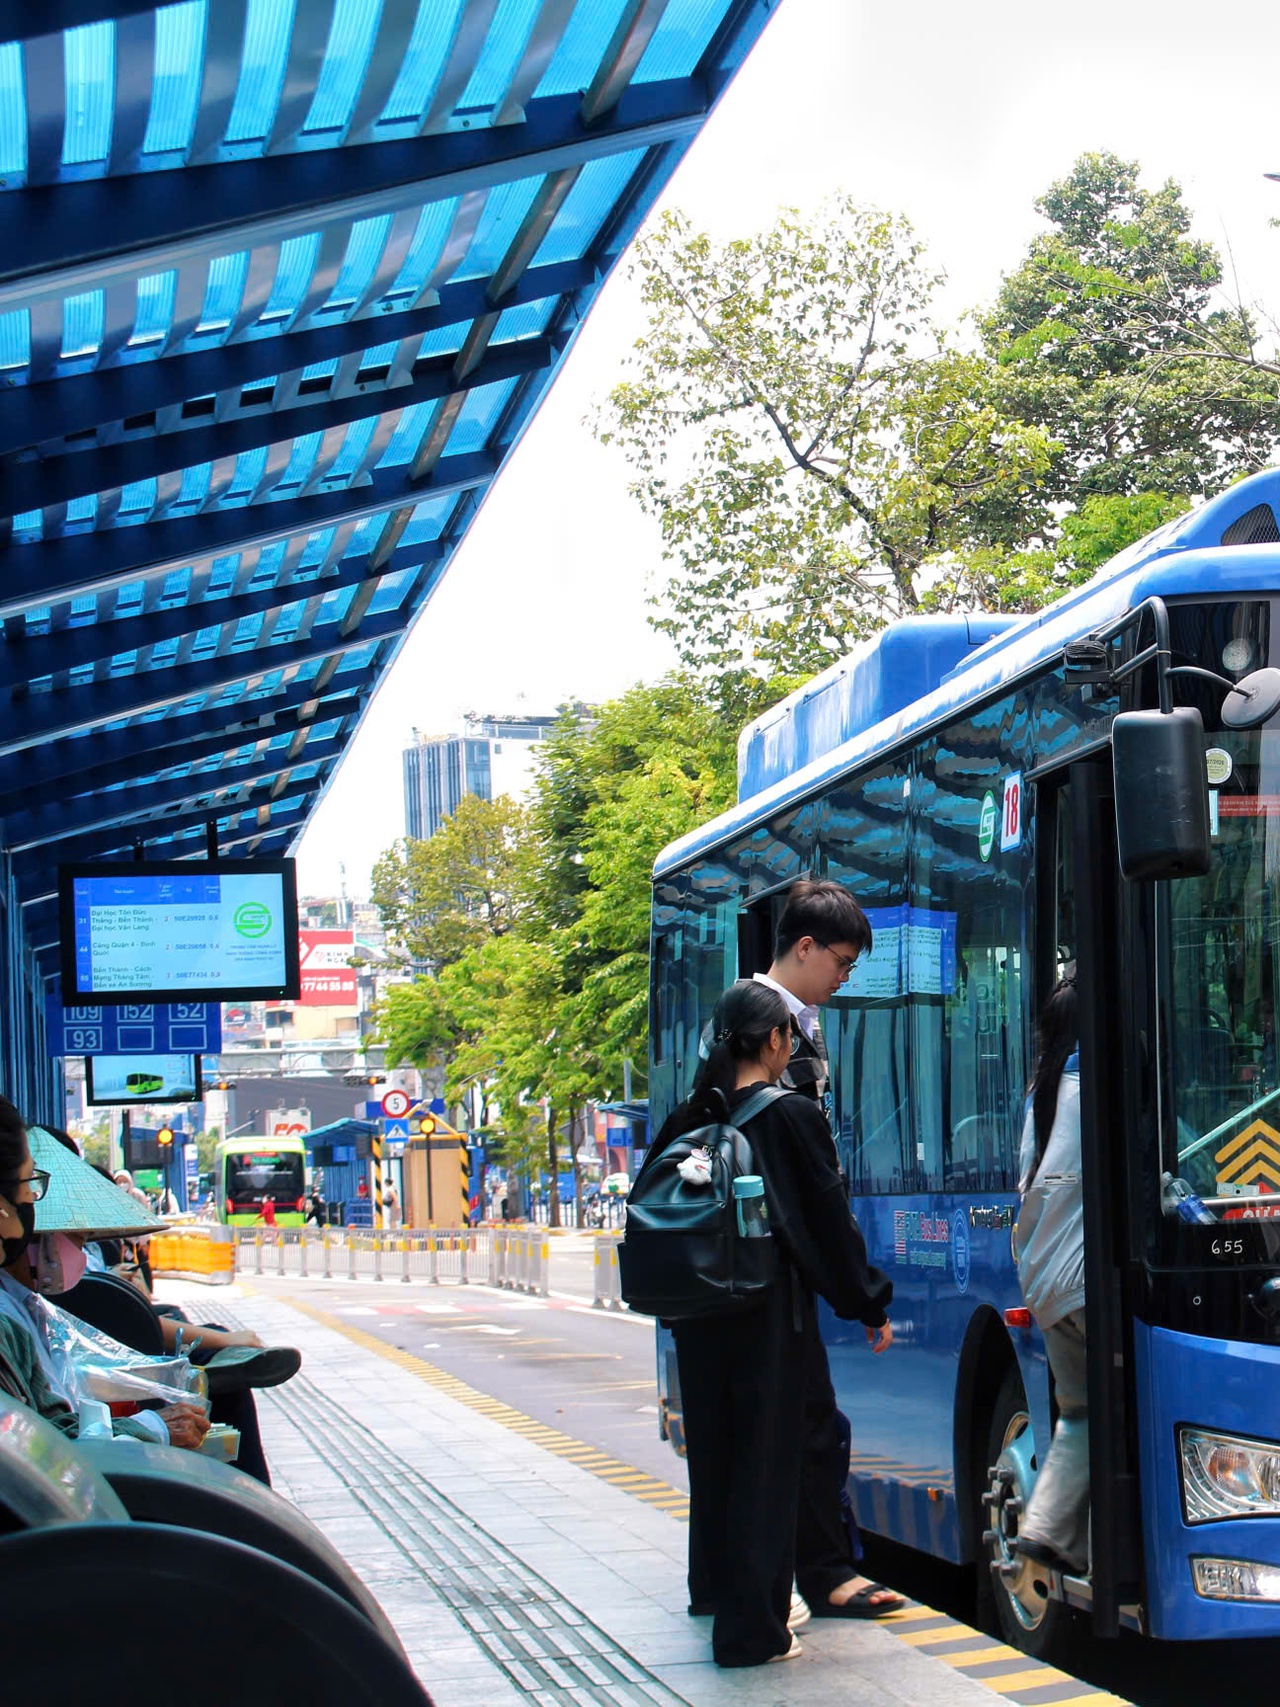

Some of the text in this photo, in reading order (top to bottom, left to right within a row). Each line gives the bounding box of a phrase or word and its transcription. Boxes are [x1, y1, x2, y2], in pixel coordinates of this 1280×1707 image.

[1005, 783, 1019, 838] 18
[70, 1003, 202, 1020] 109 152 52
[73, 1030, 97, 1049] 93
[393, 1097, 400, 1110] 5
[1211, 1239, 1244, 1254] 655
